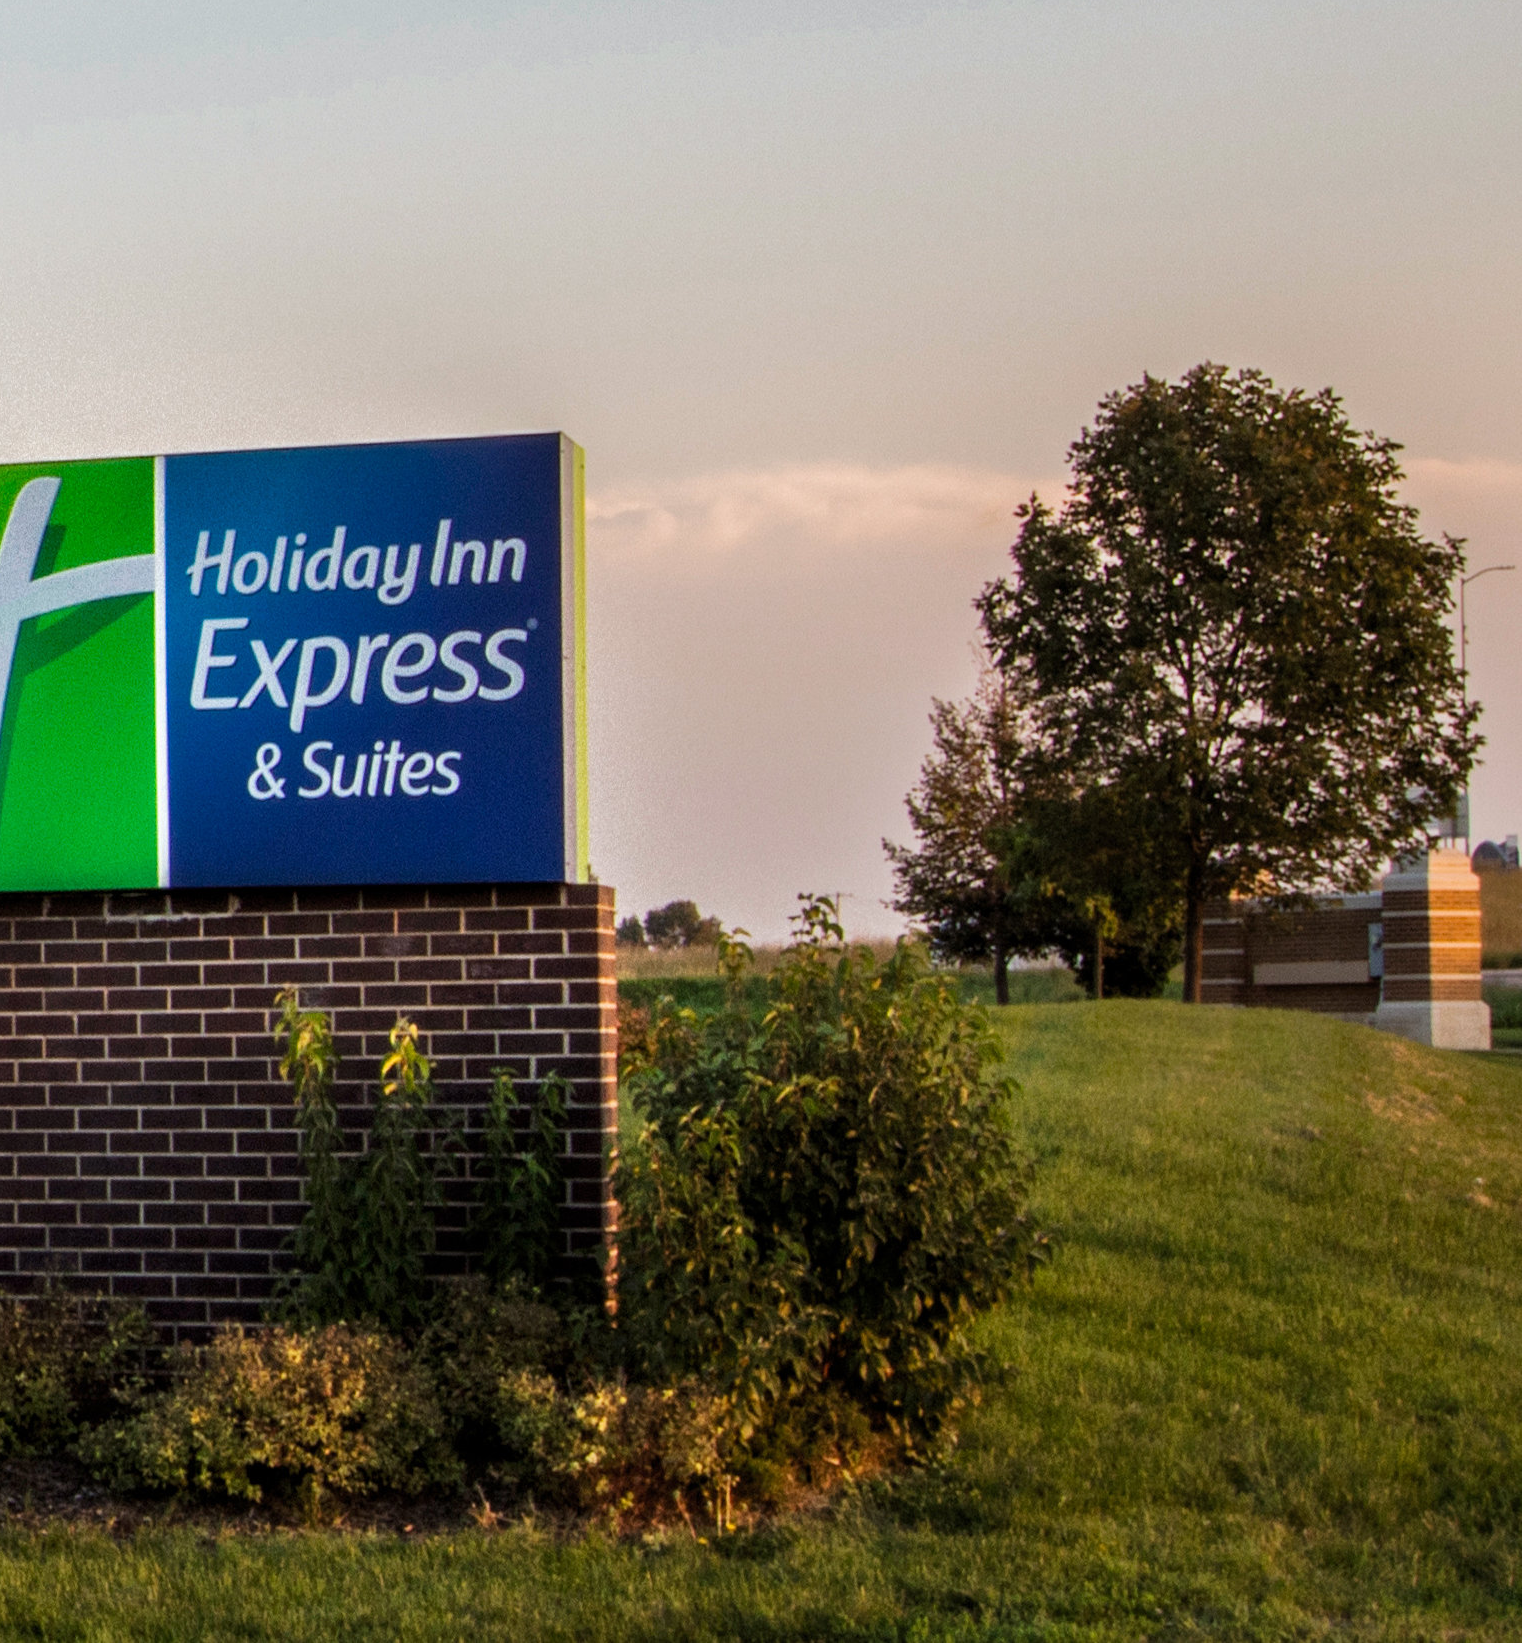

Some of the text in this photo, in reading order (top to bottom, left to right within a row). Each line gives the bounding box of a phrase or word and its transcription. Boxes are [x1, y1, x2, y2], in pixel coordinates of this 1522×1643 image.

[186, 518, 528, 606] Holiday Inn
[190, 617, 529, 734] Express
[247, 739, 462, 800] & Suites
